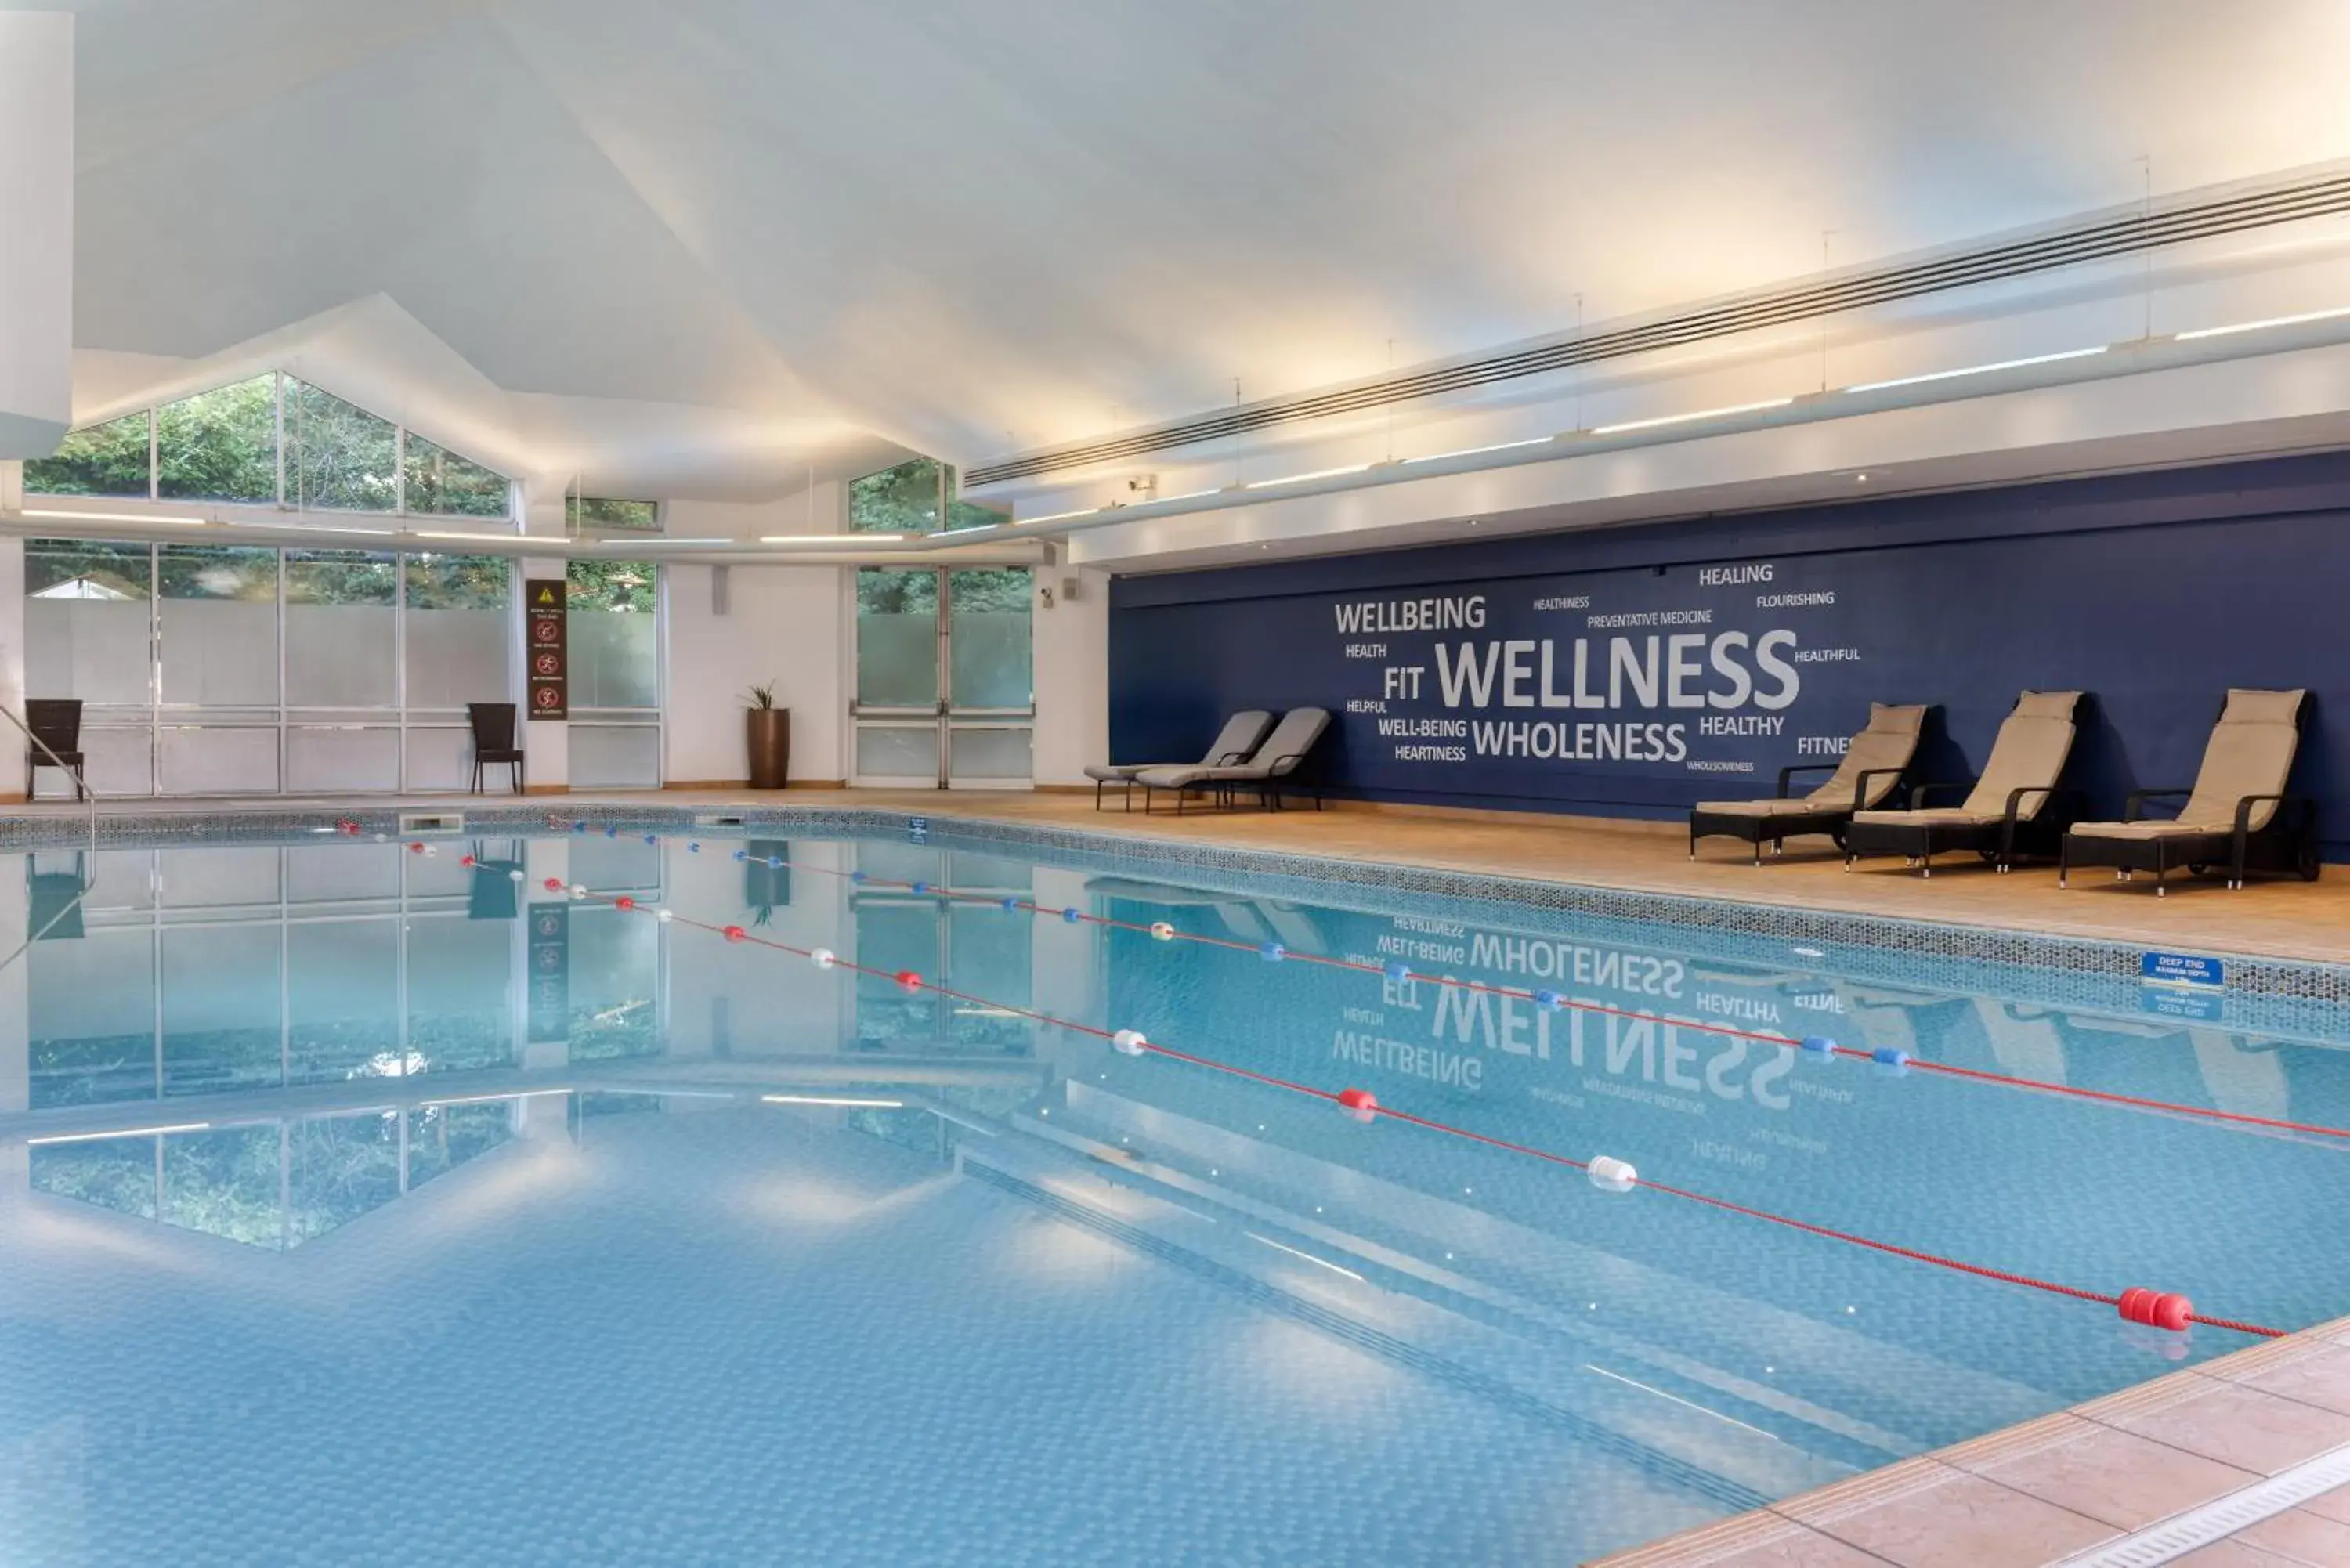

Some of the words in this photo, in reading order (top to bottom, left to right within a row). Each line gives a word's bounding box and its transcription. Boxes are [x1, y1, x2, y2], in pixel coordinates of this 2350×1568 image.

[1699, 564, 1773, 587] HEALING
[1533, 595, 1589, 610] HEALTHINESS
[1756, 591, 1835, 608] FLOURISHING
[1334, 596, 1486, 634] WELLBEING
[1587, 612, 1658, 627] PREVENTATIVE
[1660, 609, 1713, 625] MEDICINE
[1345, 643, 1387, 659] HEALTH
[1795, 648, 1861, 663] HEALTHFUL
[1434, 629, 1799, 710] WELLNESS
[1384, 667, 1425, 699] FIT
[1347, 699, 1387, 714] HELPFUL
[1379, 718, 1467, 738] WELL-BEING
[1700, 716, 1785, 735] HEALTHY
[1472, 720, 1687, 762] WHOLENESS
[1395, 745, 1466, 761] HEARTINESS
[2159, 956, 2183, 966] DEEP
[2185, 959, 2205, 970] END
